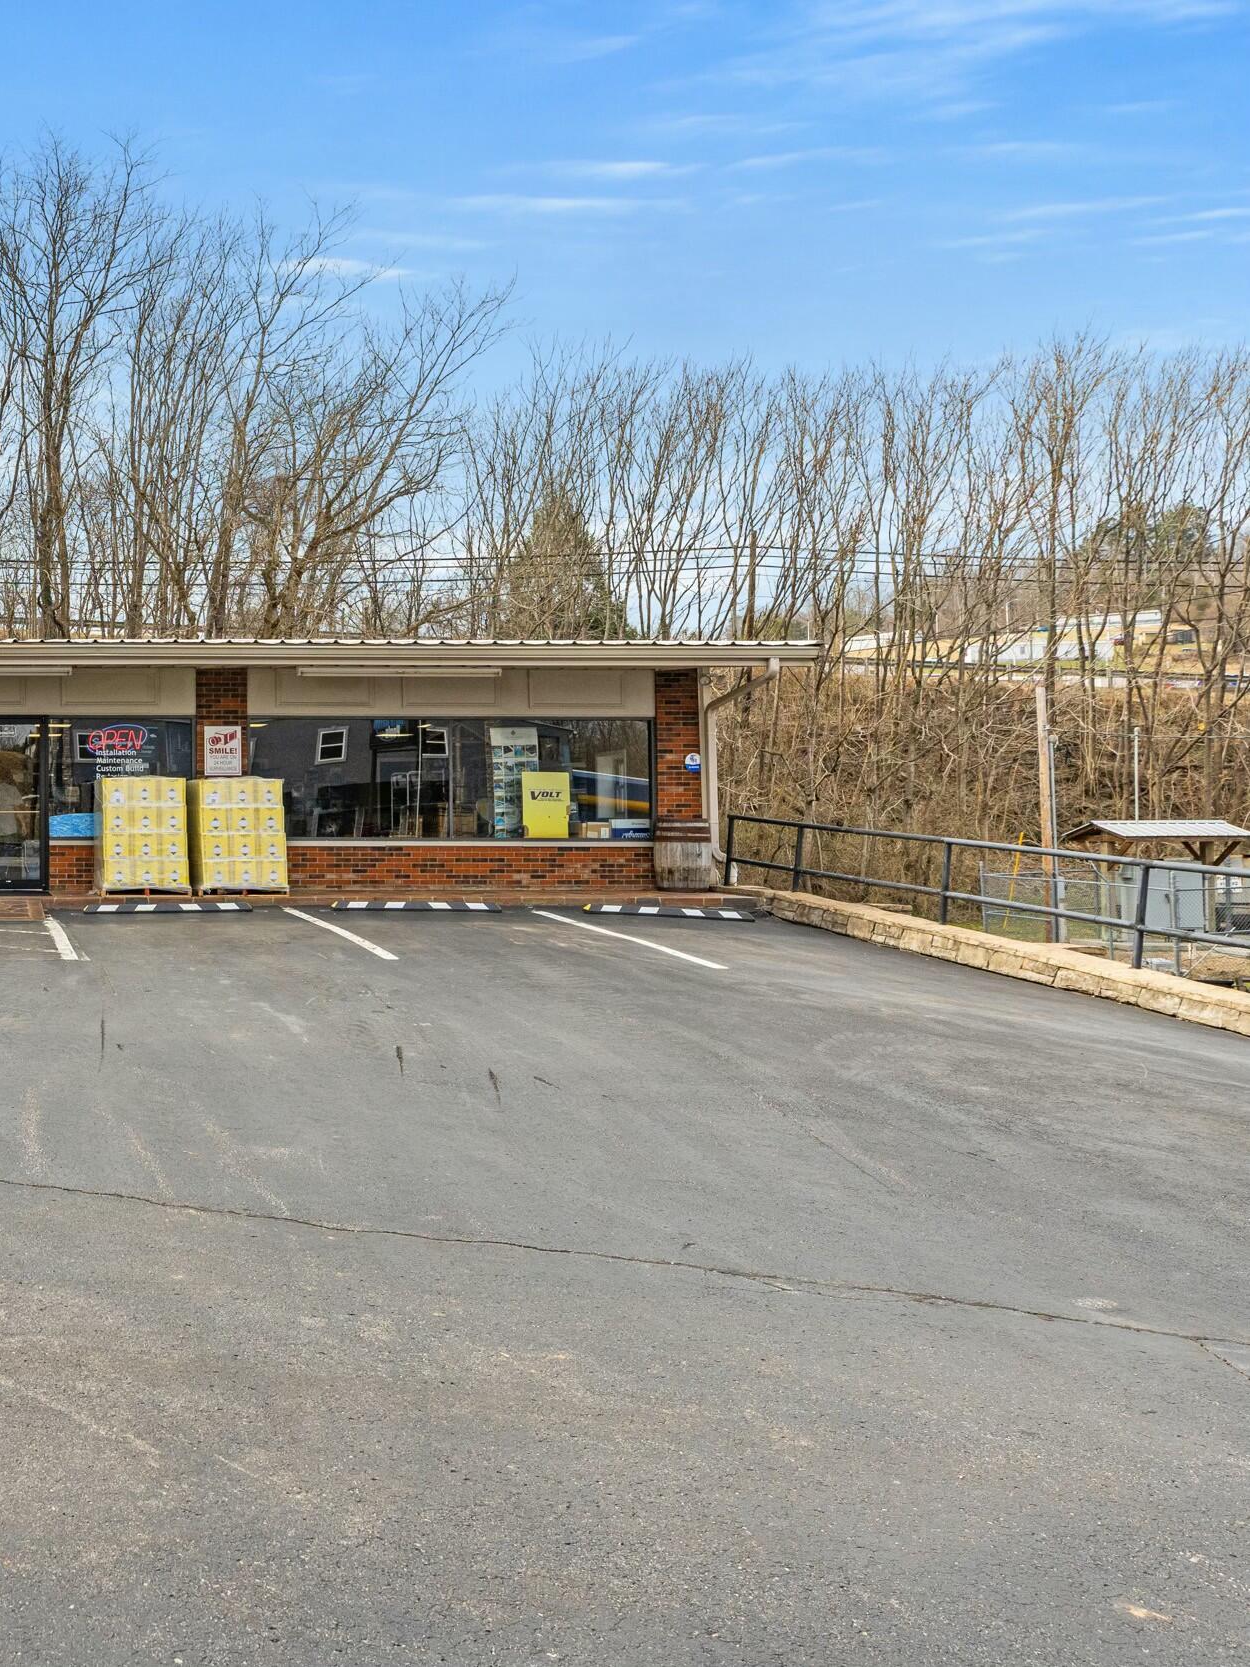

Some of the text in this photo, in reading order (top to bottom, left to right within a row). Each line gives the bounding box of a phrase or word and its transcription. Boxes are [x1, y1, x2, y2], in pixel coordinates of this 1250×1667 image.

[88, 730, 143, 750] OPEN
[125, 764, 144, 772] Build
[530, 791, 562, 800] VOLT
